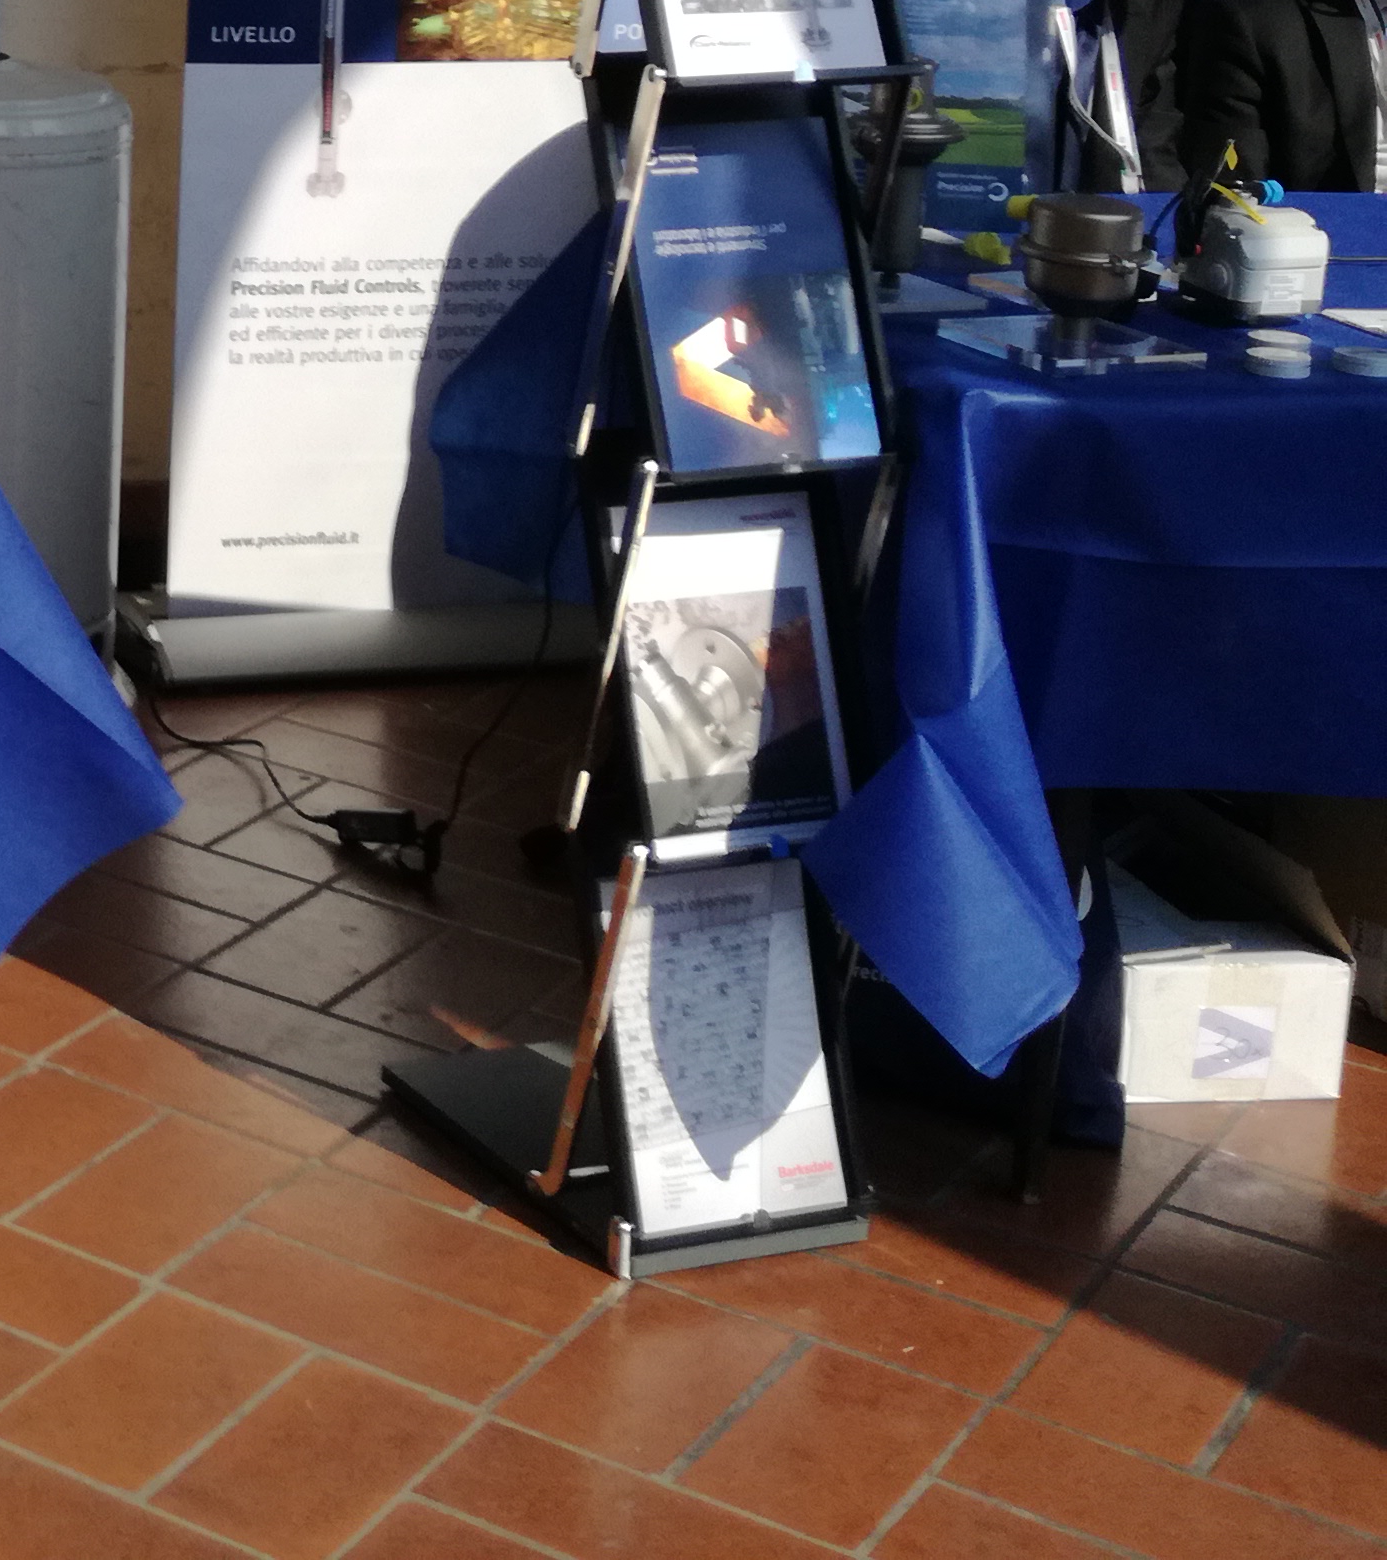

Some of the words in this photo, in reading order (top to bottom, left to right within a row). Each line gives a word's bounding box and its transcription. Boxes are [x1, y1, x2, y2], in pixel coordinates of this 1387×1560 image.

[211, 26, 296, 43] LIVELLO
[231, 280, 304, 295] Precision
[310, 279, 349, 294] Fluid
